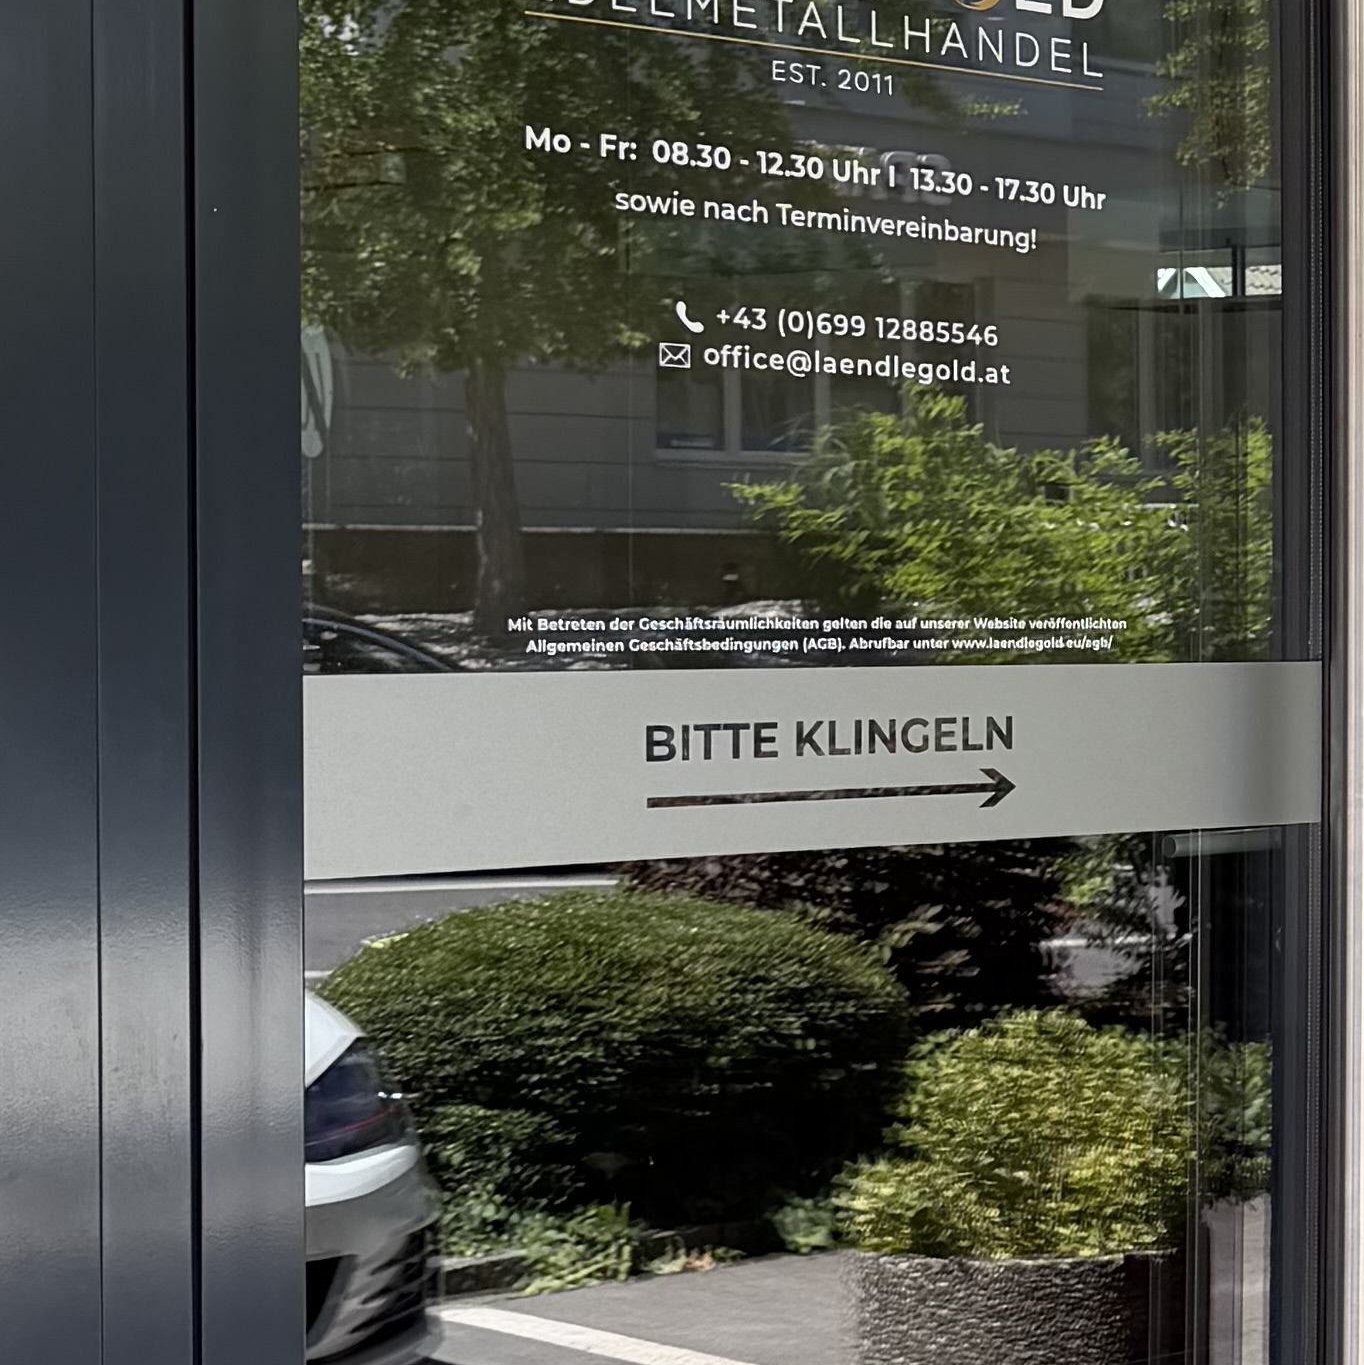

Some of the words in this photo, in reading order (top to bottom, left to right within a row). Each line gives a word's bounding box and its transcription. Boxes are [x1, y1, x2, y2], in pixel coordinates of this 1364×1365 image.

[772, 60, 827, 86] EST.
[836, 69, 895, 97] 2011
[525, 125, 572, 154] Mo
[600, 133, 637, 161] Fr:
[651, 139, 732, 170] 08.30
[756, 150, 824, 180] 12.30
[832, 158, 881, 186] Uhr
[910, 167, 973, 196] 13.30
[995, 177, 1056, 205] 17.30
[1062, 185, 1107, 211] Uhr
[615, 191, 696, 216] sowie
[703, 199, 769, 225] nach
[775, 203, 1038, 254] Terminvereinbarung!
[716, 306, 768, 331] +43
[777, 308, 866, 340] (0)699
[875, 316, 998, 347] 12885546
[703, 344, 1012, 385] office@laendlegold.at
[507, 617, 534, 631] Mit
[537, 617, 606, 631] Betreten
[609, 617, 634, 631] der
[638, 616, 819, 631] Geschäftsräumlichkeiten
[823, 617, 867, 632] gelten
[870, 617, 892, 630] die
[895, 616, 918, 630] auf
[920, 618, 971, 630] unserer
[973, 617, 1026, 630] Website
[1028, 616, 1127, 630] veröffentlichten
[525, 638, 625, 656] Allgemeinen
[628, 637, 799, 654] Geschäftsbedingungen
[802, 636, 847, 653] (AGB).
[849, 637, 908, 650] Abrufbar
[911, 638, 949, 650] unter
[645, 722, 779, 763] BITTE
[795, 715, 1015, 758] KLINGELN
